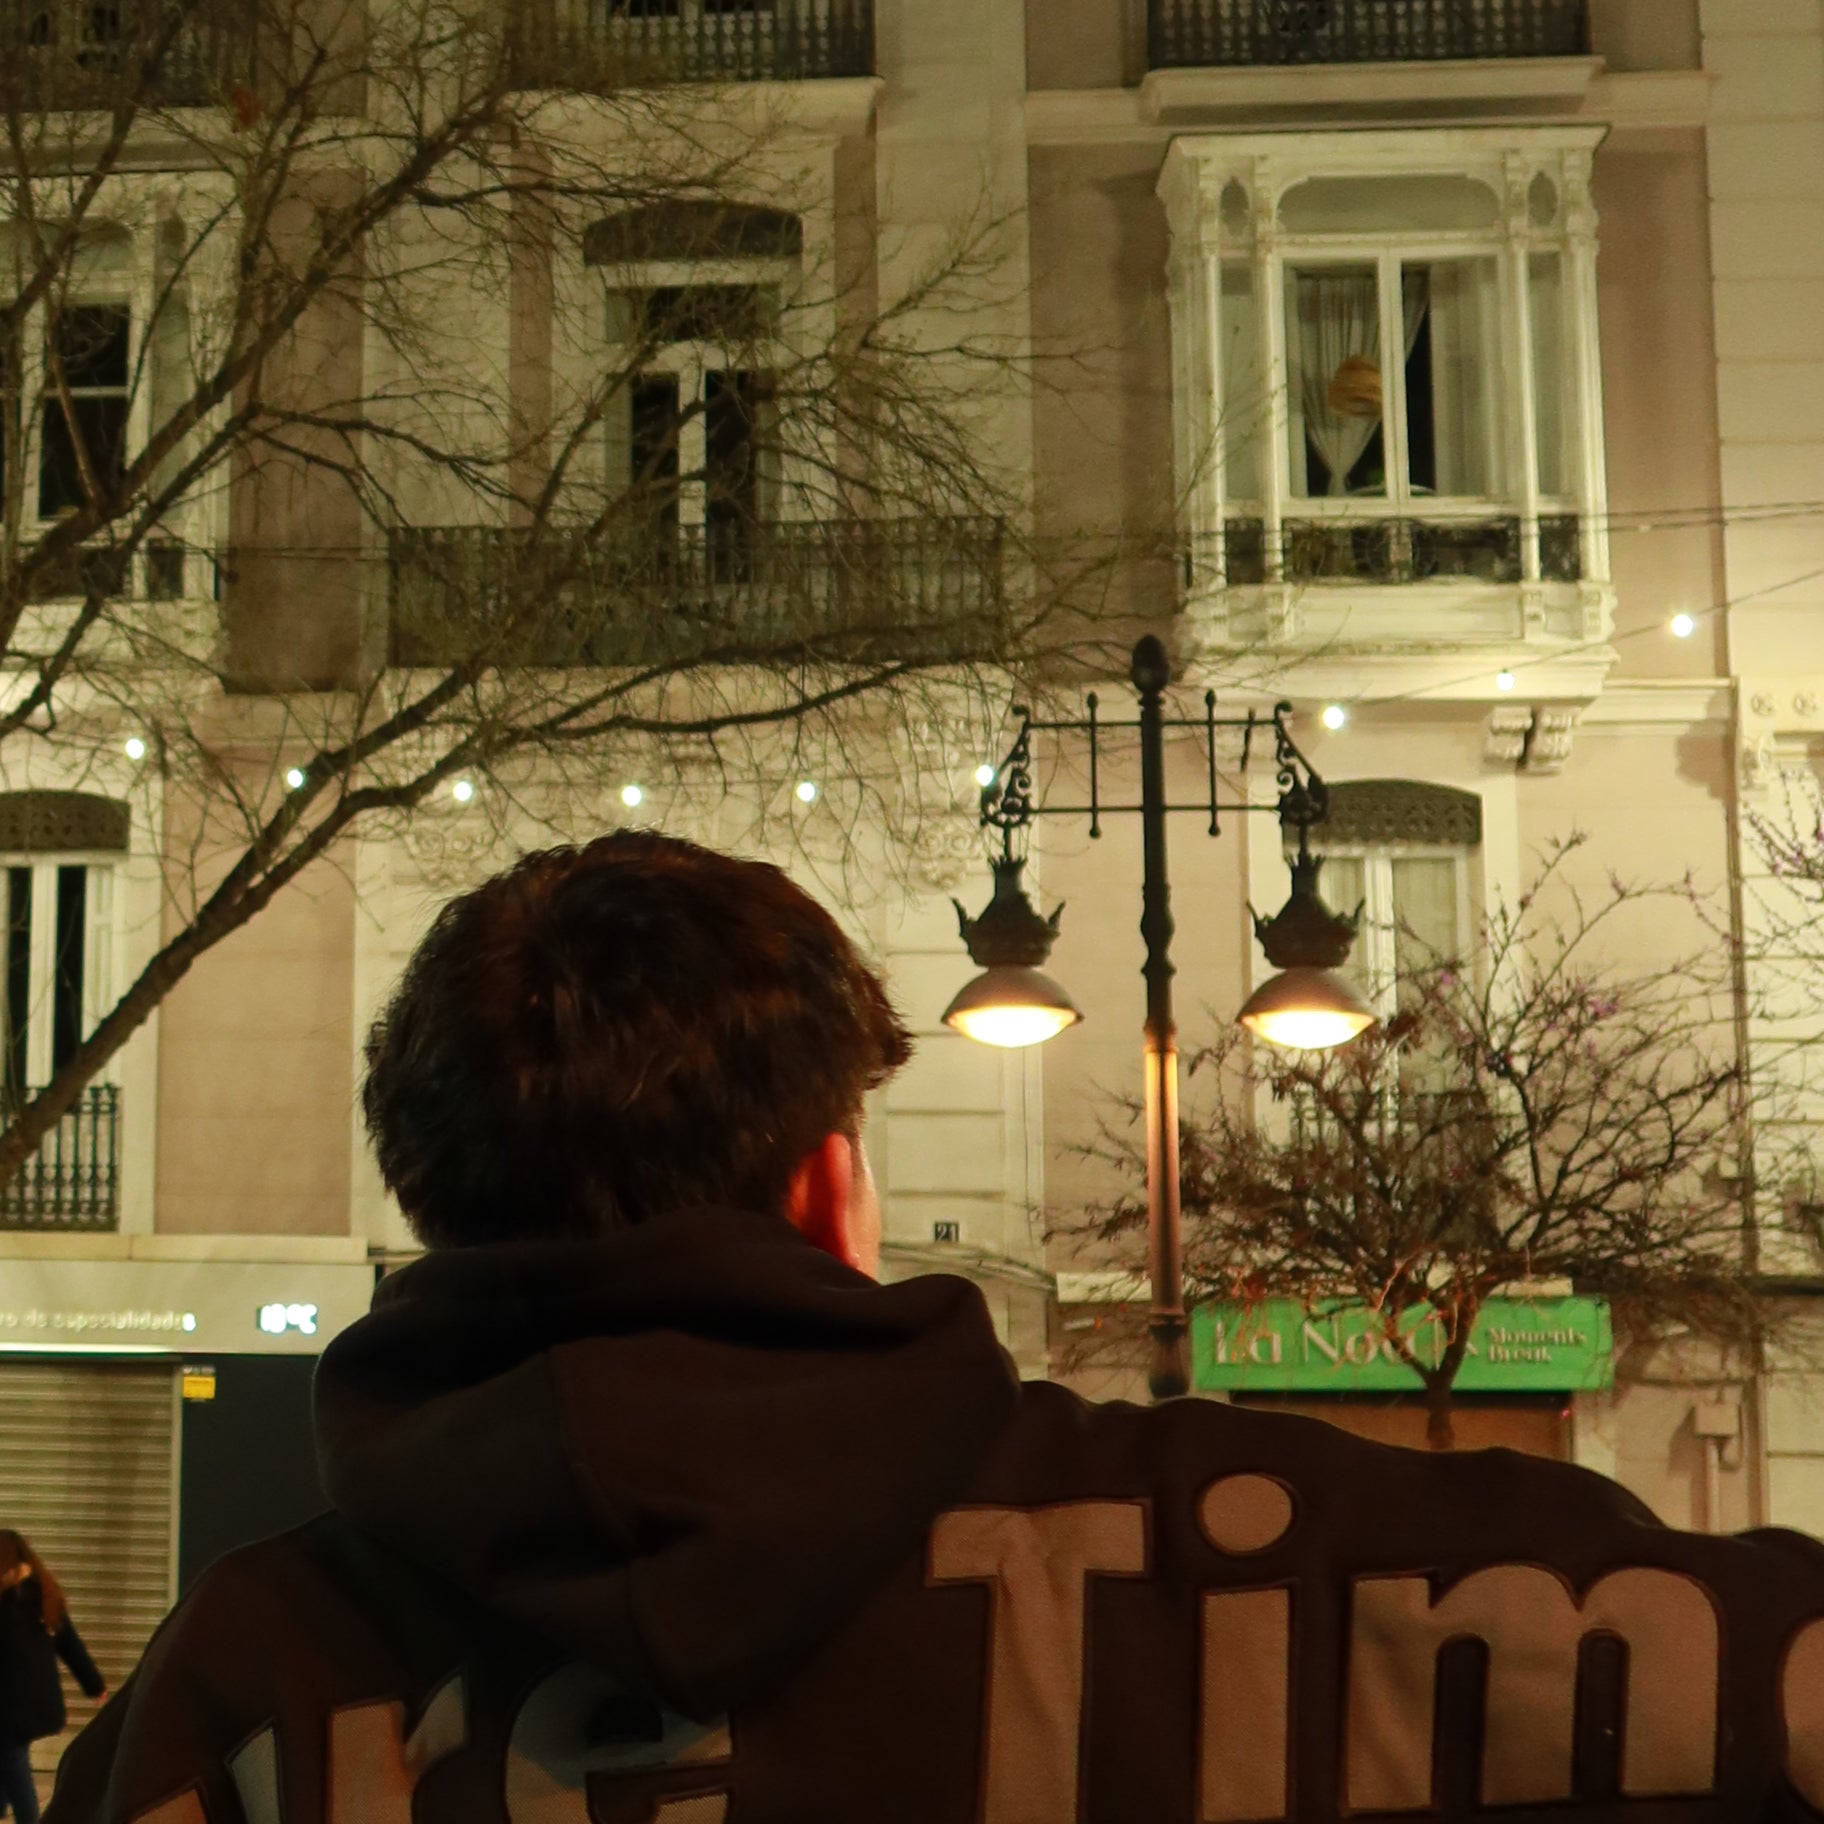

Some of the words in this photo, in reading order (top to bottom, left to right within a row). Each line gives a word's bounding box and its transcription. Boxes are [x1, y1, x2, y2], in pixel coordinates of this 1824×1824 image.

[936, 1222, 956, 1243] 21
[23, 1307, 49, 1328] de
[1215, 1318, 1281, 1364] La
